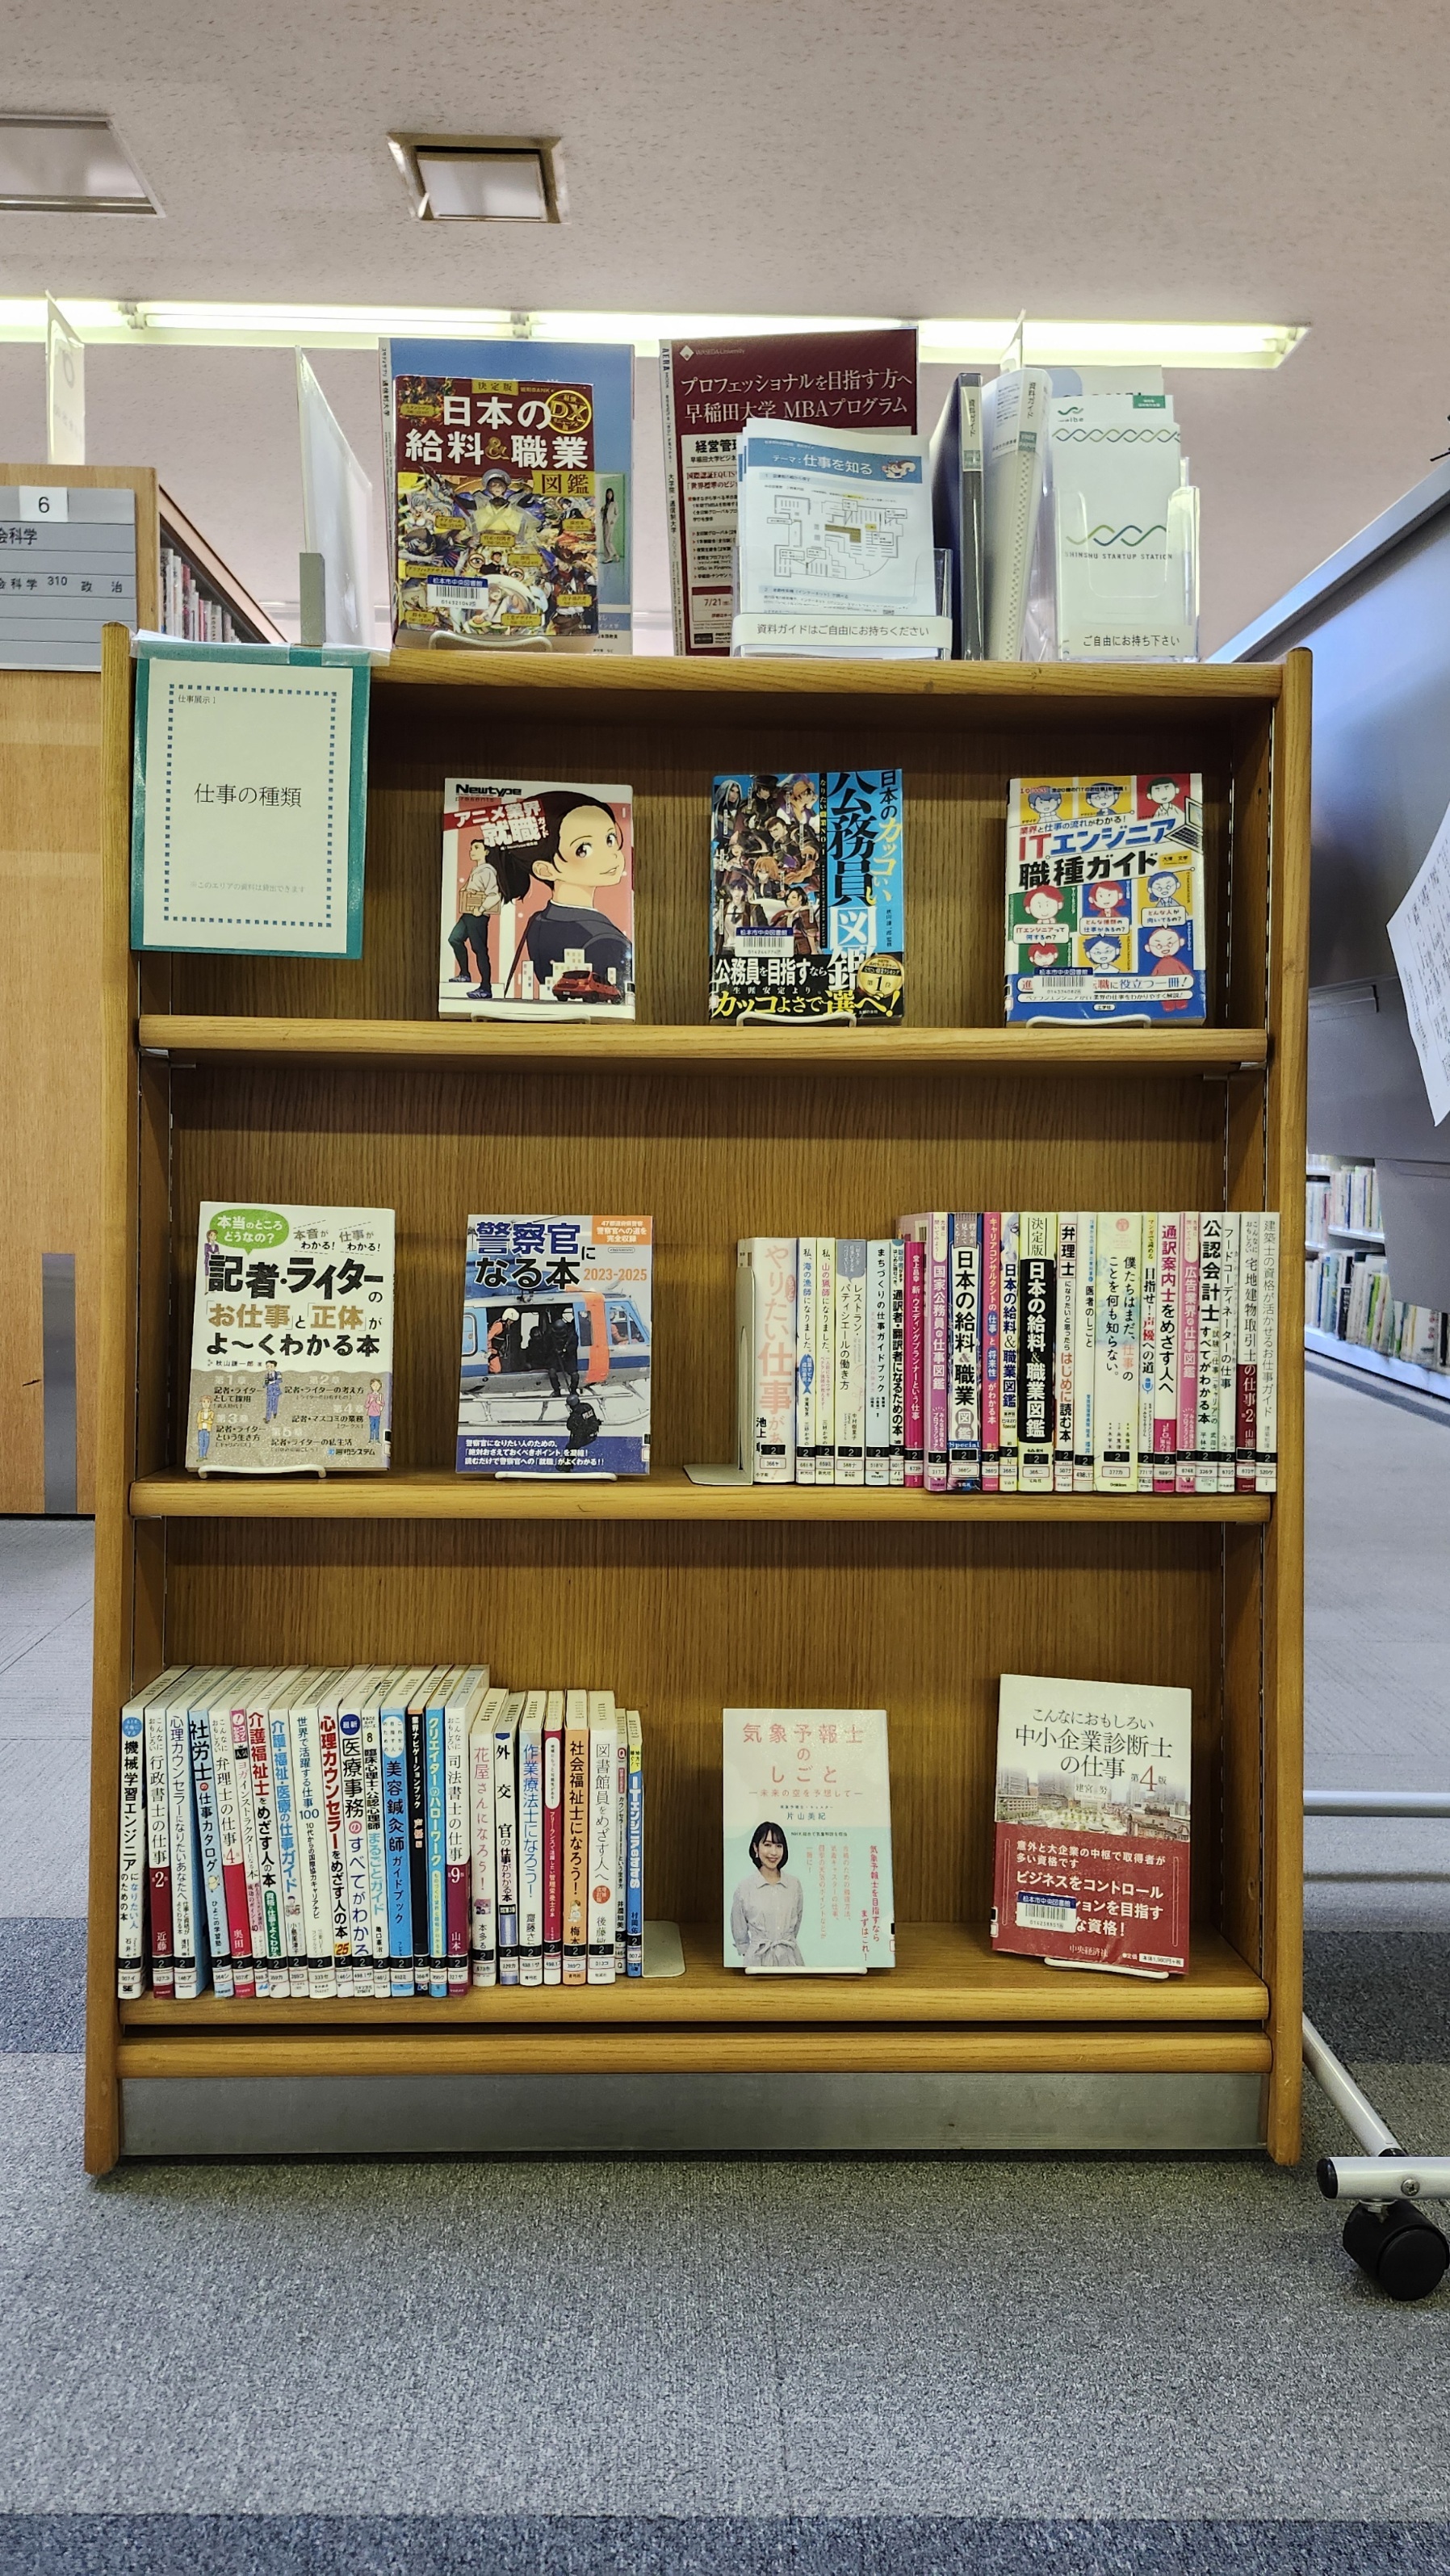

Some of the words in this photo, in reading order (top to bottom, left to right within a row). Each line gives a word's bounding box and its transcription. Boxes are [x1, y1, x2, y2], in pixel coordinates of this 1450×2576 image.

[721, 347, 745, 355] University
[478, 382, 513, 392] 決定版
[681, 368, 913, 396] プロフェッショナルを目指す方へ
[444, 396, 551, 430] 日本の
[551, 400, 588, 423] DX
[685, 401, 777, 425] 早稲田大学
[782, 401, 908, 420] MBAプログラム
[405, 429, 588, 469] 給料&職業
[542, 474, 590, 494] 図鑑
[39, 496, 50, 514] 6
[1064, 552, 1099, 560] SHINSHU
[47, 576, 68, 586] 310
[80, 581, 123, 594] 政治
[757, 623, 929, 638] 資料ガイドはご自由にお持ちください
[1083, 634, 1180, 648] ご自由にお持ち下さい
[194, 782, 302, 808] 仕事の種類
[455, 783, 522, 797] Newtype
[454, 800, 541, 828] アニメ業界
[1020, 816, 1127, 835] 業界と仕事の流れがわかる！
[480, 816, 542, 847] 就職
[537, 816, 549, 838] ガイド
[867, 770, 903, 905] 日本のカッコいい
[1019, 818, 1176, 862] ITエンジニア
[827, 771, 880, 992] 公務員図鑑
[1019, 850, 1159, 890] 職種ガイド
[1016, 926, 1065, 934] ITエンジニアって
[715, 958, 828, 986] 公務員を目指すなら
[712, 990, 901, 1017] カッコよさで選べ！
[217, 1215, 283, 1231] 本当のところ
[224, 1231, 276, 1244] どうなの？
[293, 1227, 329, 1241] 本音が
[339, 1229, 375, 1243] 仕事が
[597, 1227, 647, 1236] 警察官への道を
[1031, 1218, 1044, 1257] 決定版
[300, 1241, 336, 1251] わかる！
[346, 1242, 381, 1252] わかる！
[476, 1221, 597, 1261] 警察官に
[606, 1235, 637, 1244] 完全収録
[475, 1257, 581, 1290] なる本
[583, 1268, 648, 1282] 2023-2025
[1201, 1220, 1222, 1322] 公認会計士
[803, 1248, 812, 1353] 私、海の漁師になりました。
[821, 1248, 831, 1353] 私、山の猟師になりました。
[1158, 1225, 1177, 1394] 通訳案内士をめざす人へ
[1221, 1229, 1234, 1389] フードコーディネーターの仕事
[206, 1300, 382, 1332] 「お仕事」と「正体」が
[877, 1248, 886, 1392] まちづくりの仕事ガイドブック
[932, 1265, 946, 1390] 国家公務員の仕事図鑑
[987, 1218, 998, 1425] キャリアコンサルタントの仕事と将来性がわかる本
[1084, 1286, 1094, 1348] 医者のしごと
[1105, 1257, 1119, 1375] ことを何も知らない。
[1122, 1257, 1137, 1381] 僕たちはまだ、仕事の
[1142, 1268, 1156, 1374] 目指せ！声優への道
[1183, 1266, 1197, 1378] 広告業界の仕事図鑑
[1262, 1220, 1276, 1417] 建築士の資格が活かせるお仕事ガイド
[840, 1283, 850, 1391] パティシエールの働き方
[954, 1251, 975, 1441] 日本の給料&職業図鑑
[1003, 1264, 1016, 1408] 日本の給料&職業図鑑
[1243, 1258, 1258, 1407] 宅地建物取引士の仕事
[892, 1289, 903, 1436] 通訳者・翻訳者になるための本
[1026, 1261, 1046, 1437] 日本の給料&職業図鑑
[214, 1374, 246, 1386] 第1章
[309, 1374, 341, 1386] 第2章
[1197, 1326, 1211, 1424] すべてがわかる本
[214, 1387, 264, 1395] 記者・ライター
[284, 1386, 364, 1395] 記者・ライターの考え方
[216, 1425, 267, 1433] 記者・ライター
[291, 1416, 364, 1424] 記者・マスコミの業務
[216, 1434, 261, 1442] という生き方
[271, 1438, 353, 1447] 記者・ライターの私生活
[465, 1439, 558, 1449] 警察官になりたい人のための、
[911, 1451, 918, 1459] 2
[1142, 1455, 1149, 1463] 2
[1202, 1452, 1209, 1460] 2
[1264, 1454, 1271, 1462] 2
[342, 1720, 358, 1729] 最新
[742, 1722, 864, 1744] 気象予報士
[1033, 1707, 1155, 1731] こんなにおもしろい
[212, 1720, 221, 1752] おもしろい
[220, 1719, 228, 1752] こんなに
[367, 1732, 373, 1743] 8
[1016, 1724, 1172, 1760] 中小企業診断士
[297, 1716, 320, 1819] 世界で活躍する仕事100
[411, 1716, 421, 1809] 業界ナビゲーションブック
[796, 1747, 811, 1761] の
[1060, 1755, 1125, 1780] の仕事
[769, 1765, 838, 1784] しごと
[1130, 1764, 1167, 1793] 第4版
[123, 1740, 139, 1871] 機械学習エンジニア
[190, 1719, 217, 1872] 社労士の仕事カタログ
[216, 1756, 237, 1846] 弁理士の仕事
[249, 1712, 276, 1888] 介護福祉士をめざす人の本
[271, 1720, 297, 1893] 介護・福祉・医療の仕事ガイド
[429, 1718, 442, 1866] クリエイターのハローワーク
[149, 1756, 166, 1865] 行政書士の仕事
[170, 1715, 187, 1900] 心理カウンセラーになりたいあなたへ
[238, 1762, 258, 1880] ヨガインストラクターになる本
[447, 1755, 463, 1861] 司法書士の仕事
[474, 1747, 489, 1890] 花屋さんになろう！
[522, 1743, 539, 1898] 作業療法士になろう！
[568, 1740, 585, 1895] 社会福祉士になろう！
[593, 1743, 610, 1881] 図書館員をめざす人へ
[786, 1811, 826, 1821] 片山美紀
[321, 1715, 348, 1939] 心理カウンセラーをめざす人の本
[496, 1743, 515, 1903] 外交官の仕事がわかる本
[342, 1737, 369, 1956] 医療事務のすべてがわかる
[386, 1760, 404, 1924] 美容鍼灸師ガイドブック
[1016, 1840, 1167, 1865] 意外と大企業の中枢で取得者が
[305, 1823, 320, 1919] 10代からの国際協力キャリアナビ
[1016, 1853, 1079, 1869] 多い資格です
[120, 1873, 129, 1921] のための本
[870, 1844, 880, 1942] 気象予報士を目指すなら
[1016, 1869, 1164, 1899] ビジネスをコントロール
[129, 1873, 139, 1929] になりたい人
[1022, 1895, 1071, 1907] 松本市中央図書館
[451, 1932, 461, 1951] 山本
[631, 1938, 638, 1946] 2
[861, 1909, 870, 1961] まずはこれ！
[179, 1960, 186, 1968] 2
[256, 1960, 262, 1968] 2
[317, 1959, 323, 1967] 2
[377, 1959, 383, 1968] 2
[434, 1960, 441, 1968] 2
[505, 1949, 512, 1957] 2
[1070, 1944, 1108, 1958] 中央経済社
